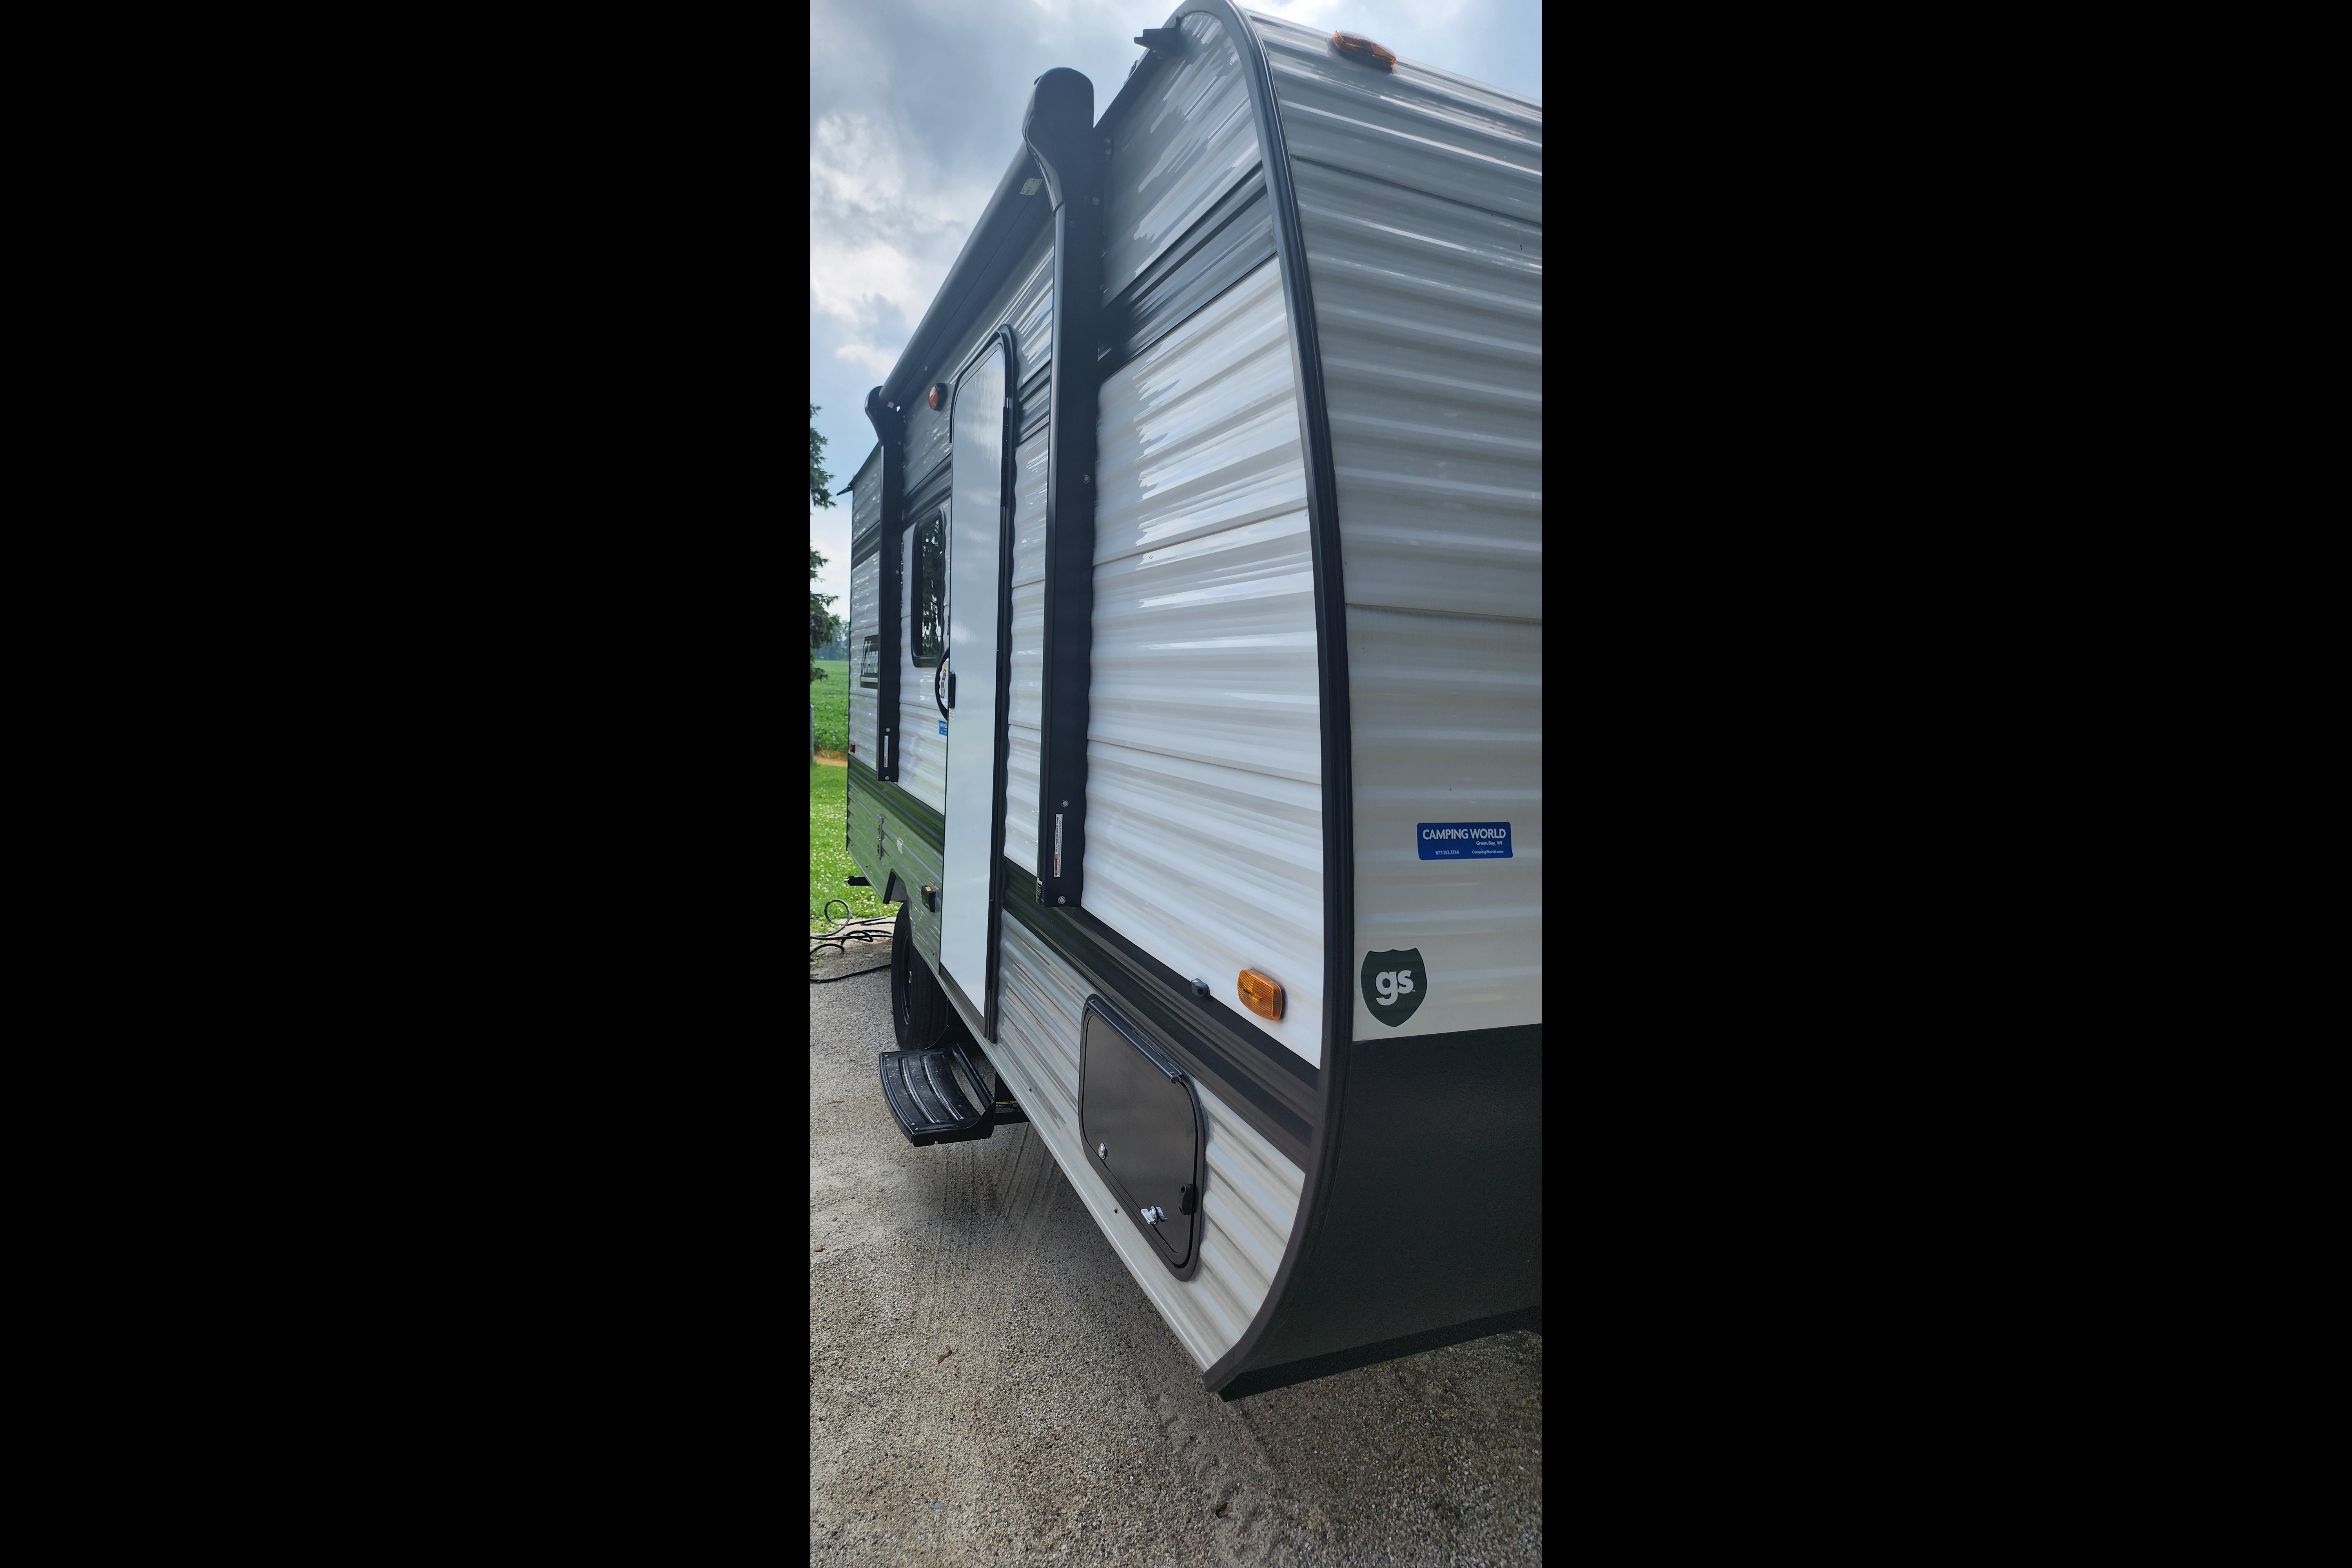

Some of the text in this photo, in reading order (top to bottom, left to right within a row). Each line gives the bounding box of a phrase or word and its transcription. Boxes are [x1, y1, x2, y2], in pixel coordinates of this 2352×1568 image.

[1422, 828, 1506, 840] CAMPING WORLD
[1375, 970, 1414, 1006] gs
